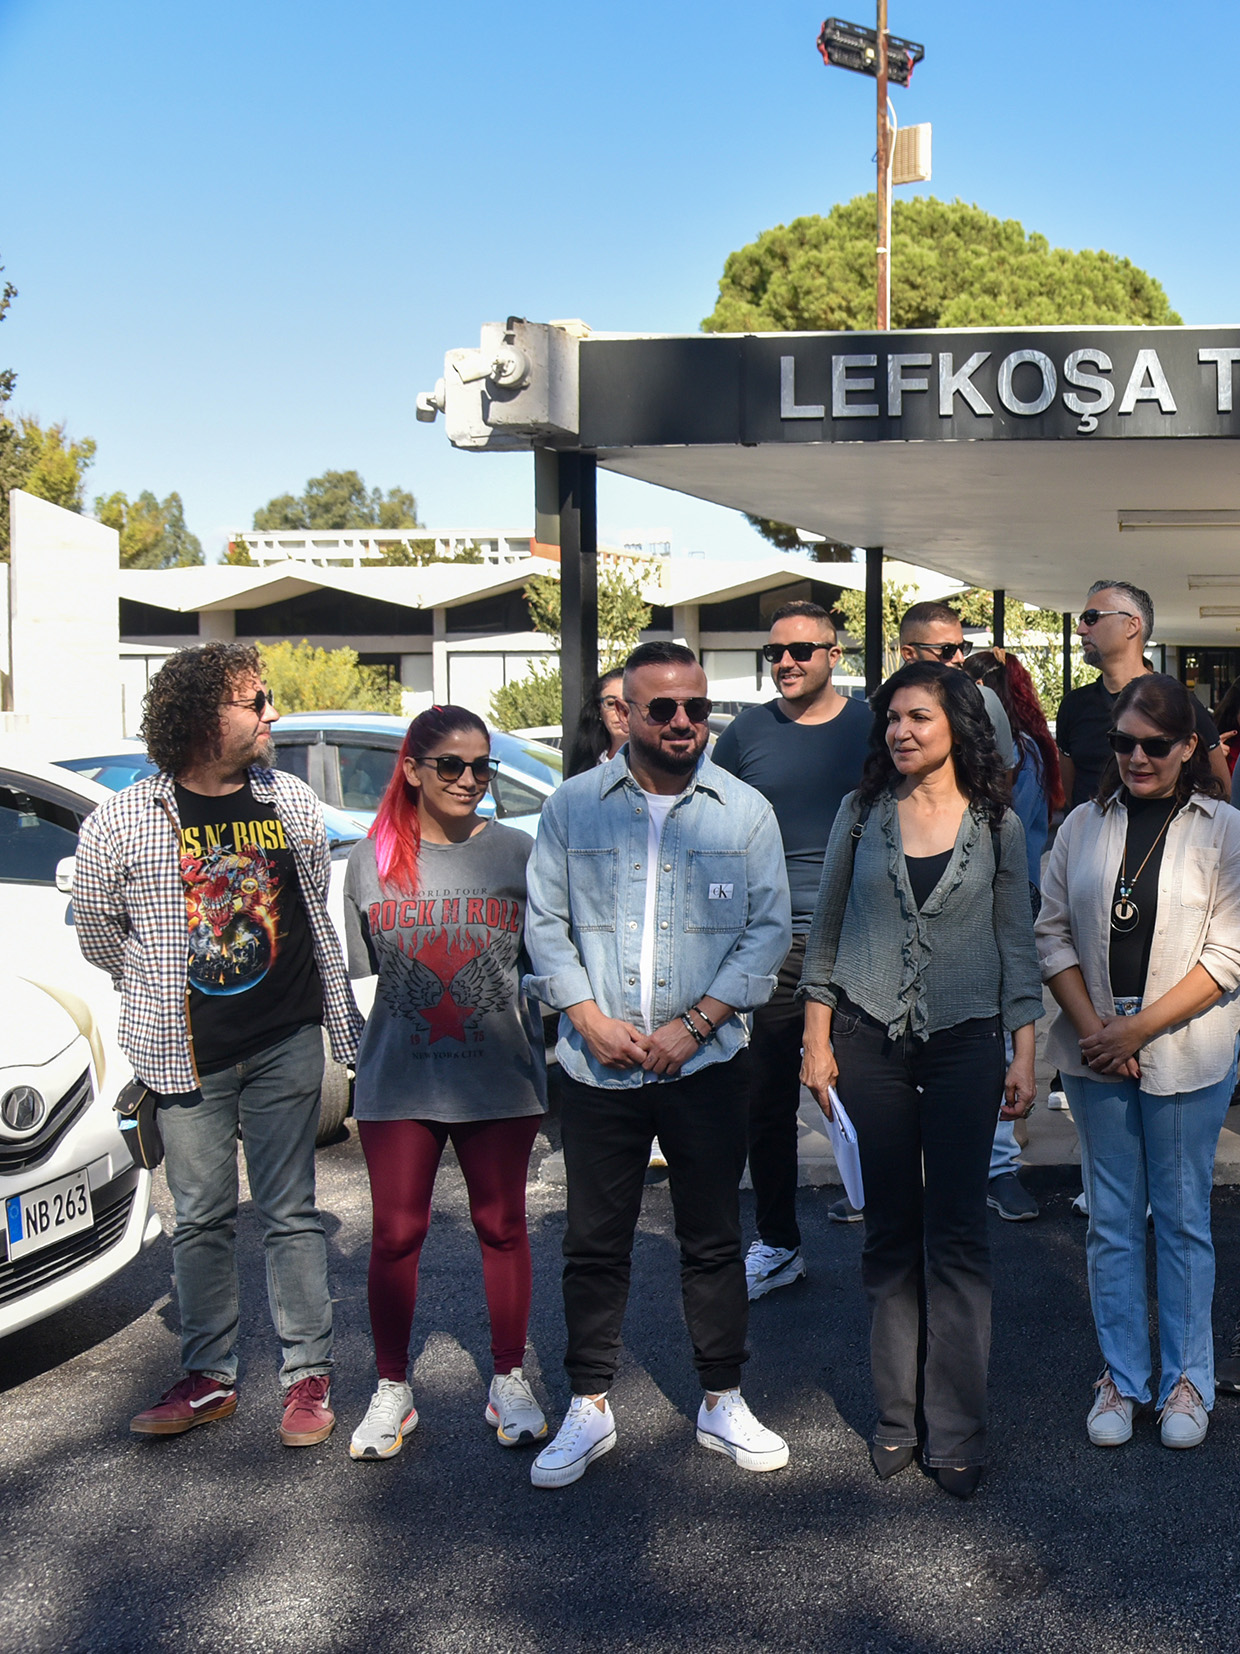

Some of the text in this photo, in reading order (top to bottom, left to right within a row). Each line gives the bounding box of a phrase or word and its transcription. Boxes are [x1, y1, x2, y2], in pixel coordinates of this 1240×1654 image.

[780, 348, 1178, 434] LEFKOŞA
[455, 887, 488, 896] TOUR
[369, 899, 435, 936] ROCK
[466, 897, 519, 933] ROLL
[412, 1049, 485, 1060] NEW YORK CITY
[25, 1183, 87, 1239] NB 263
